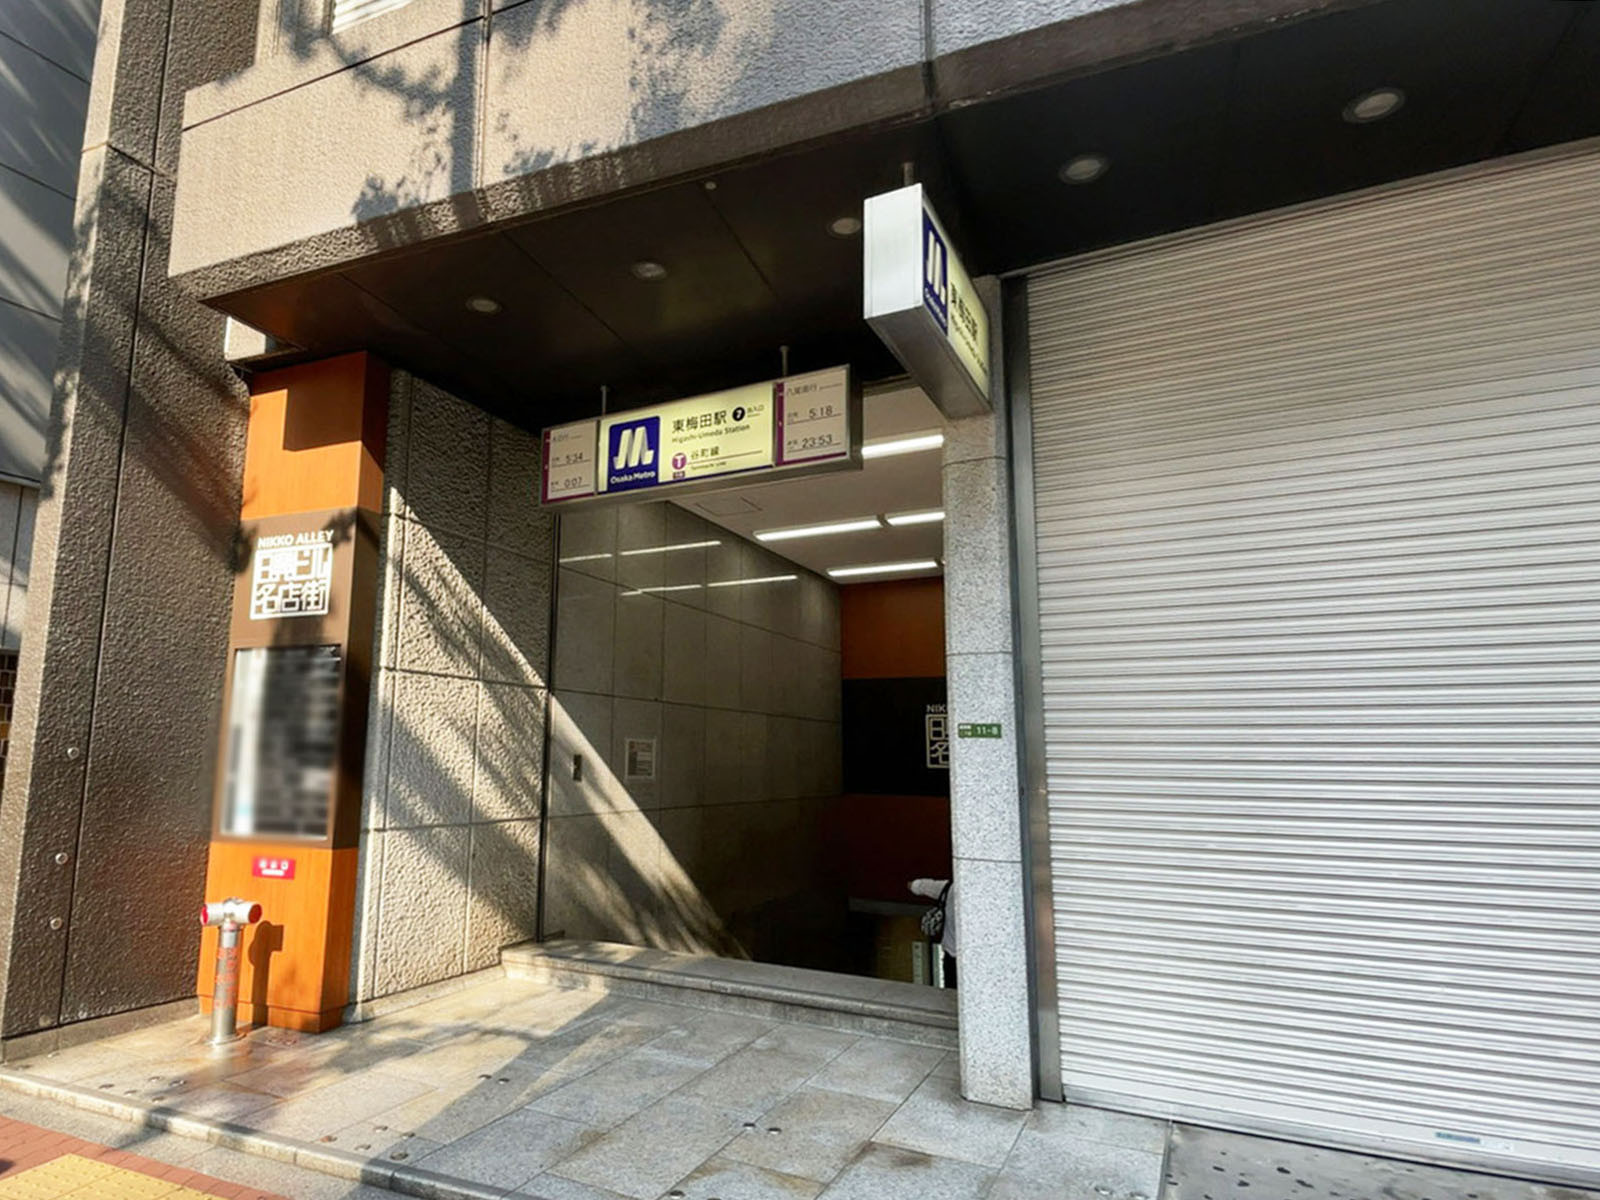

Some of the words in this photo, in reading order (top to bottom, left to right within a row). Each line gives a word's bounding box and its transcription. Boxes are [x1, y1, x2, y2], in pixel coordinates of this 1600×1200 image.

[672, 410, 727, 434] 東梅田駅
[724, 424, 751, 436] Station
[801, 434, 833, 449] 23:53
[691, 446, 720, 460] 谷町線
[610, 474, 633, 484] Osaka
[633, 471, 656, 480] Metro
[257, 533, 295, 549] NIKKO
[296, 529, 334, 545] ALLEY
